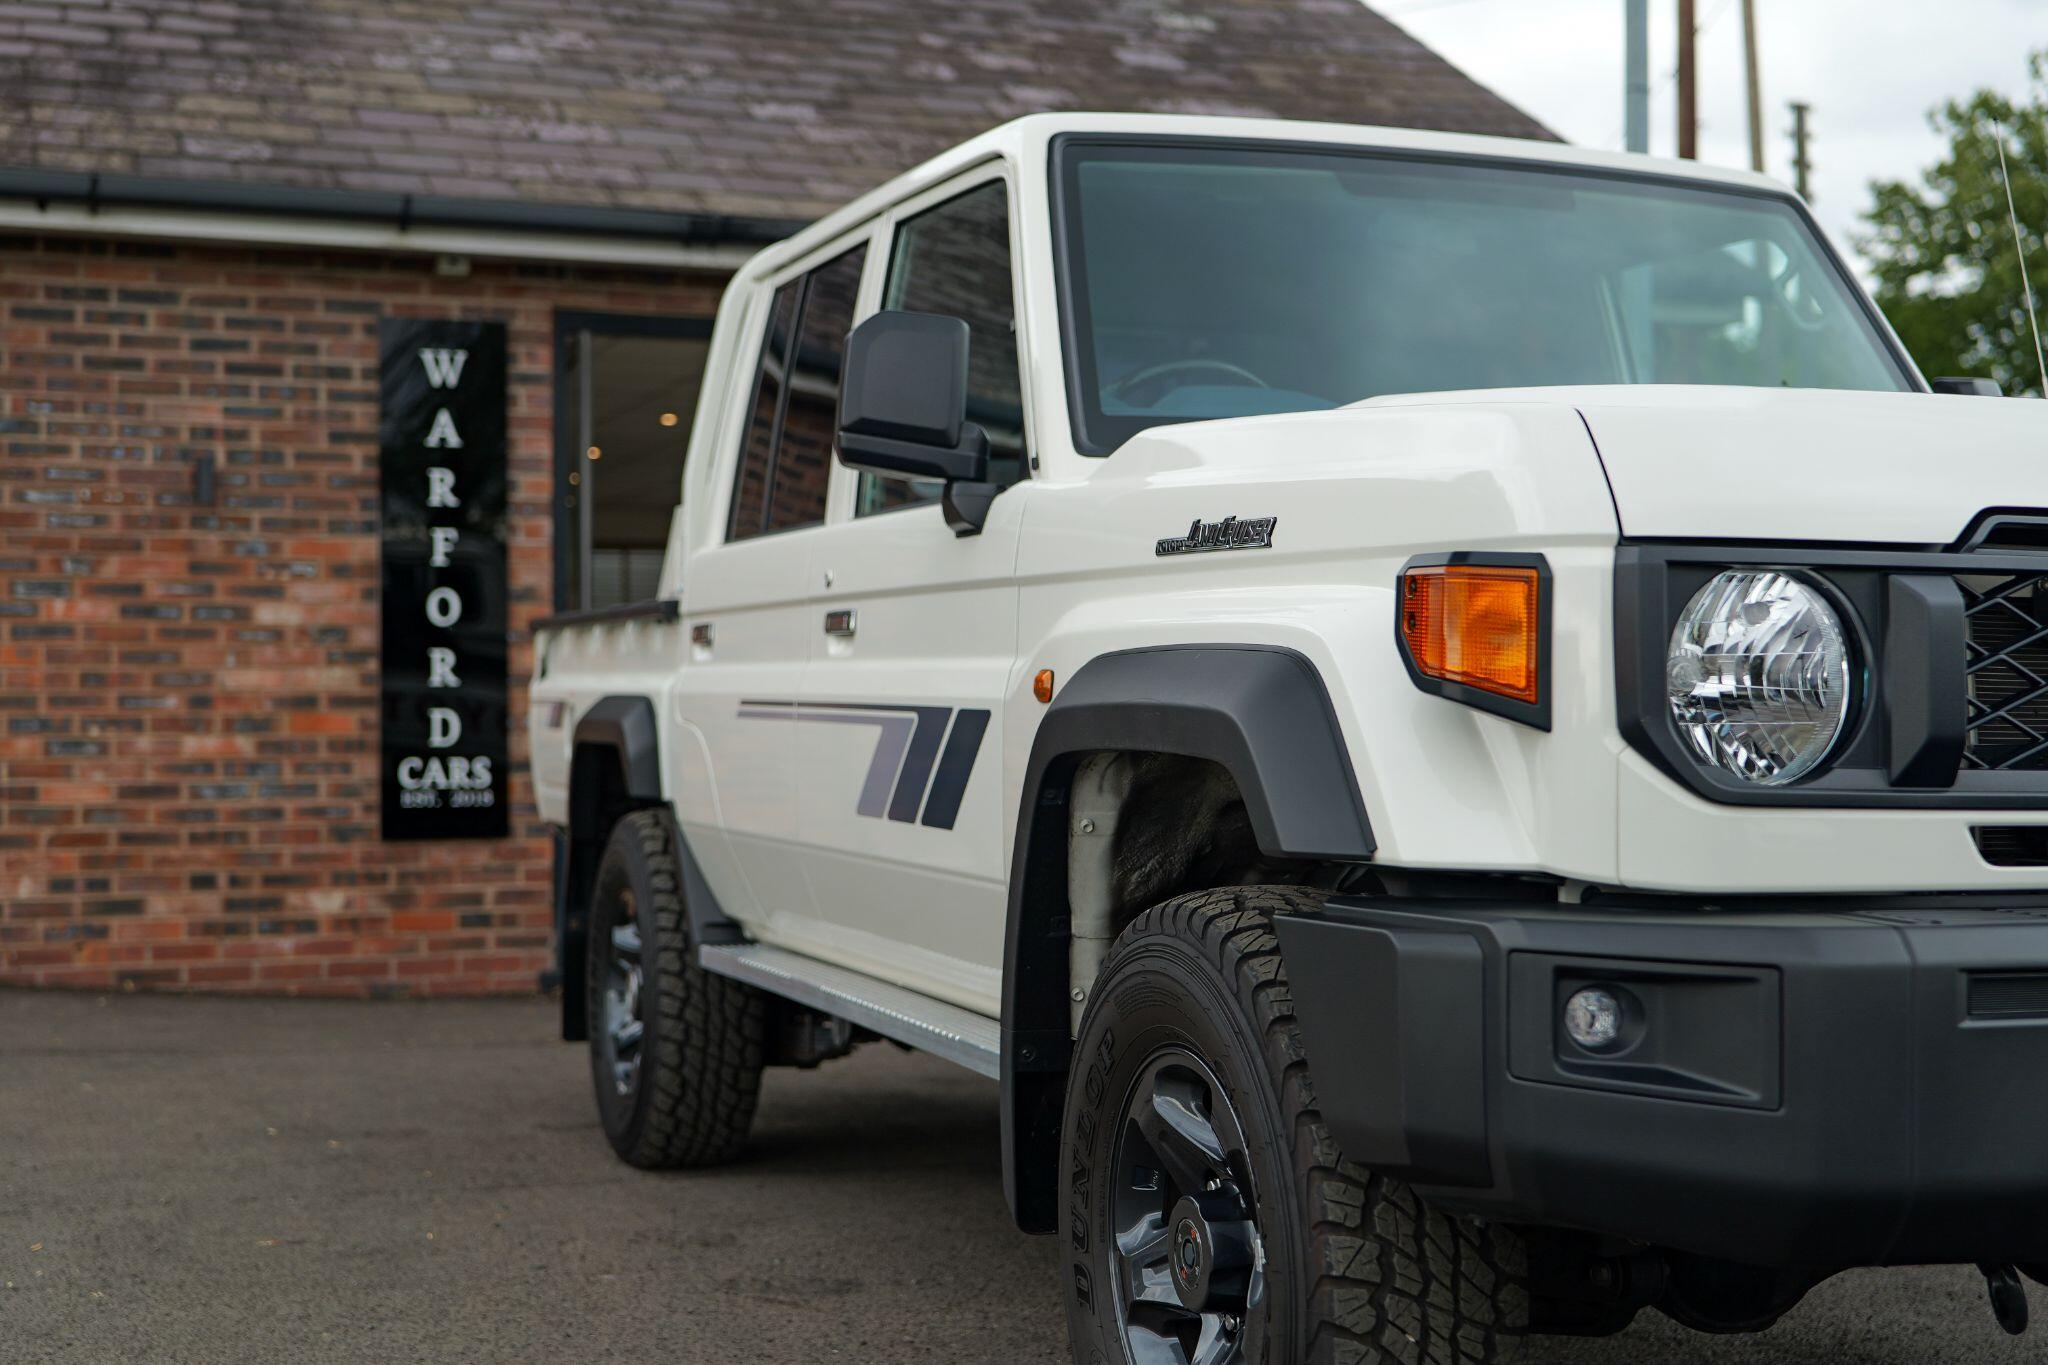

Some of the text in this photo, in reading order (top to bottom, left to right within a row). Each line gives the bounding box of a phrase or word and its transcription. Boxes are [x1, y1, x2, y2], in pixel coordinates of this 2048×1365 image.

[419, 348, 469, 748] WARFORD
[397, 755, 493, 790] CARS
[1071, 1026, 1116, 1315] DUNLOP
